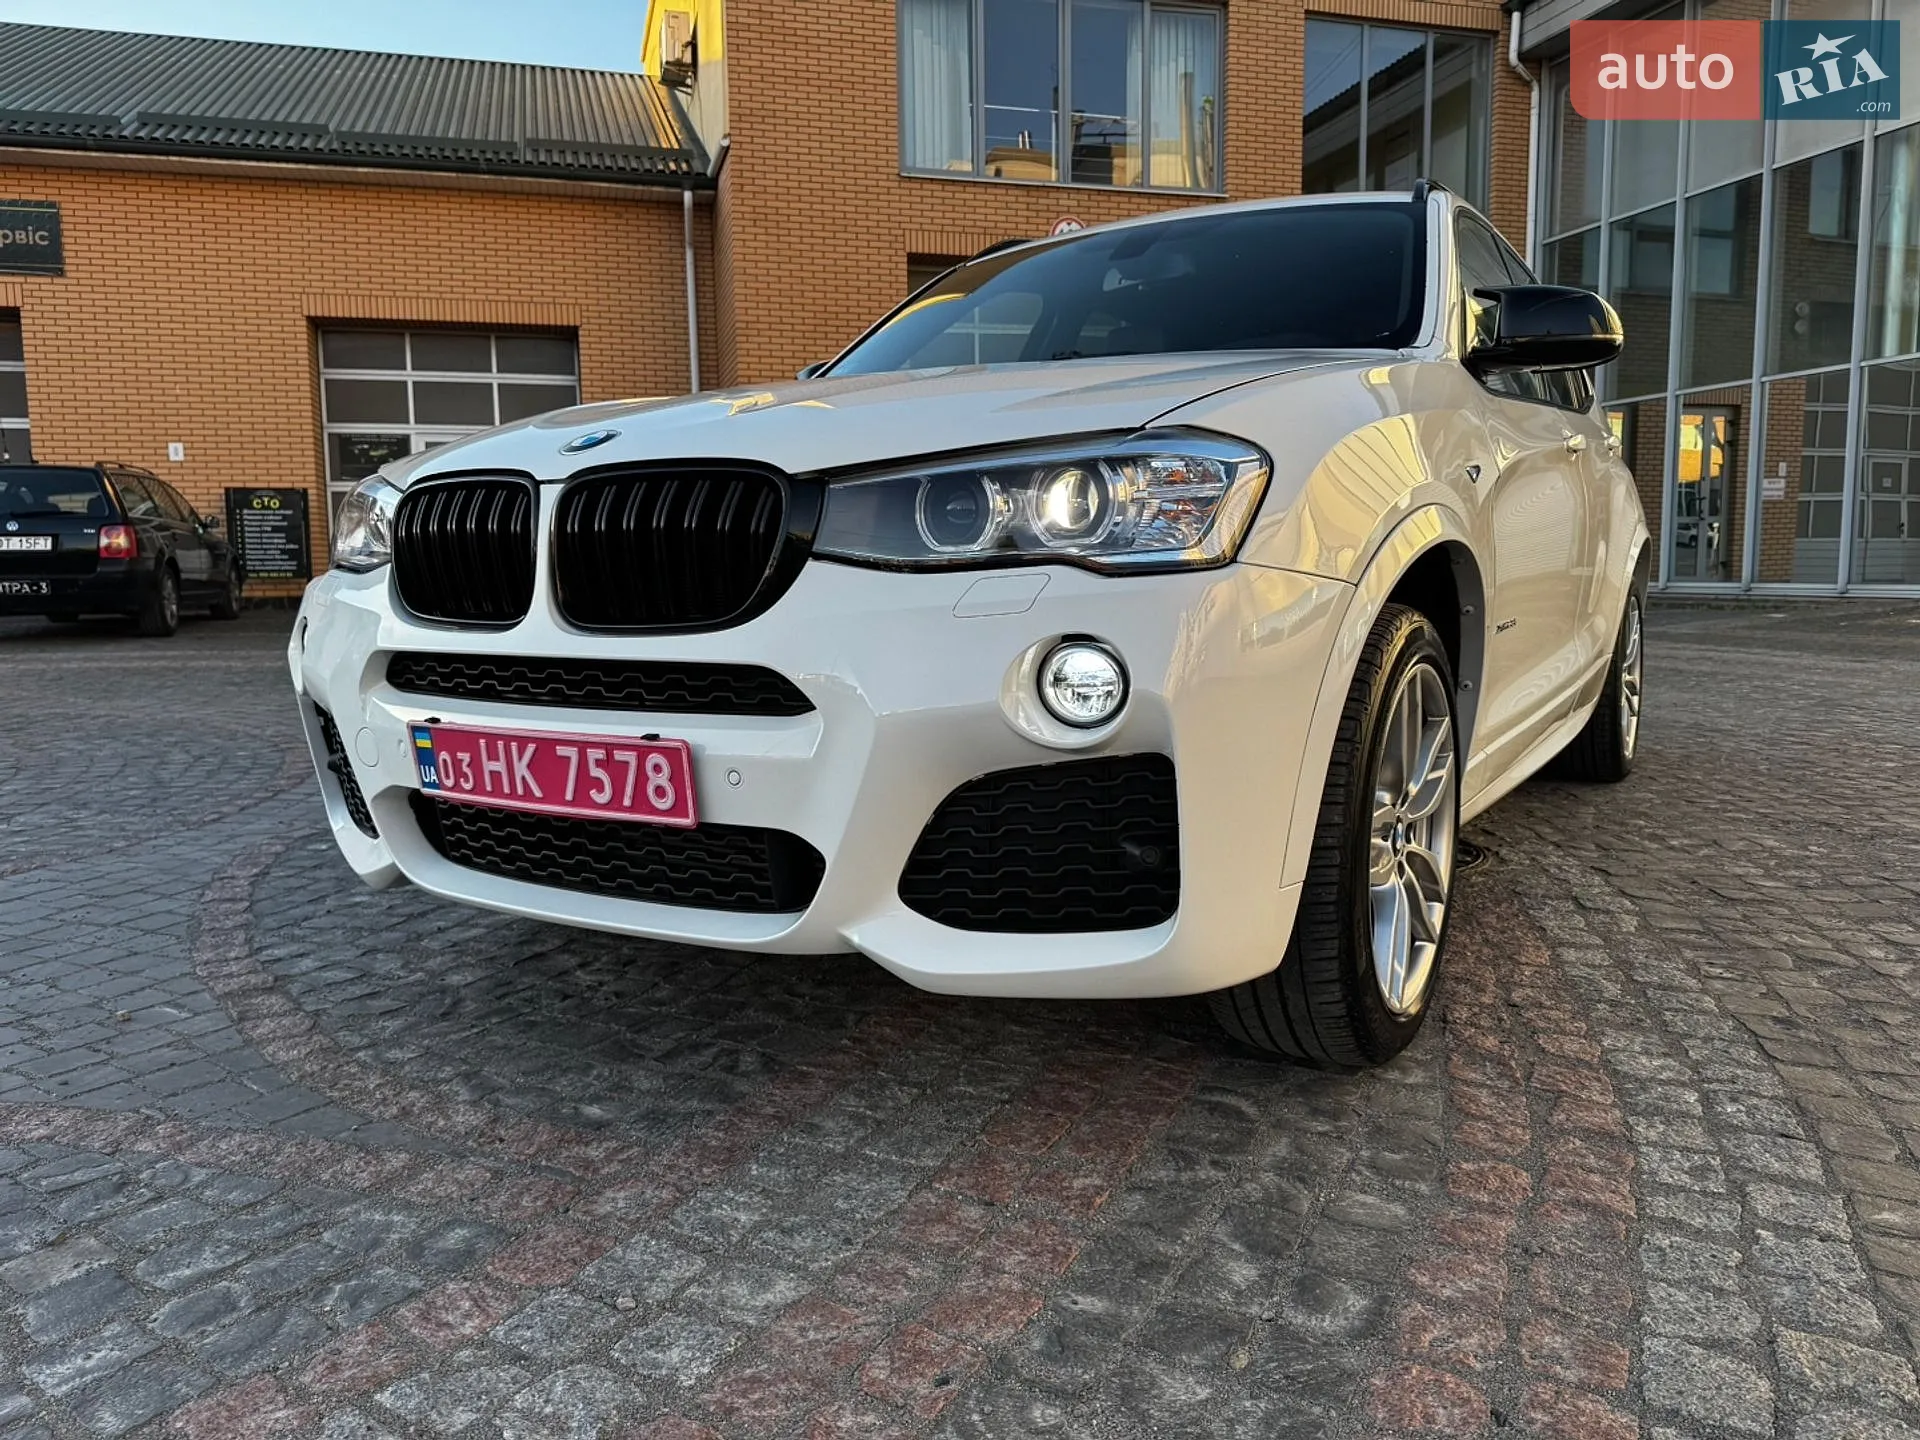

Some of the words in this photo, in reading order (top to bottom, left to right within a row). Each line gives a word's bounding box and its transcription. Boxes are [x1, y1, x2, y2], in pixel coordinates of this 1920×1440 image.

[421, 765, 439, 784] UA
[438, 750, 474, 791] 03
[479, 738, 543, 799] HK
[556, 745, 676, 811] 7578
